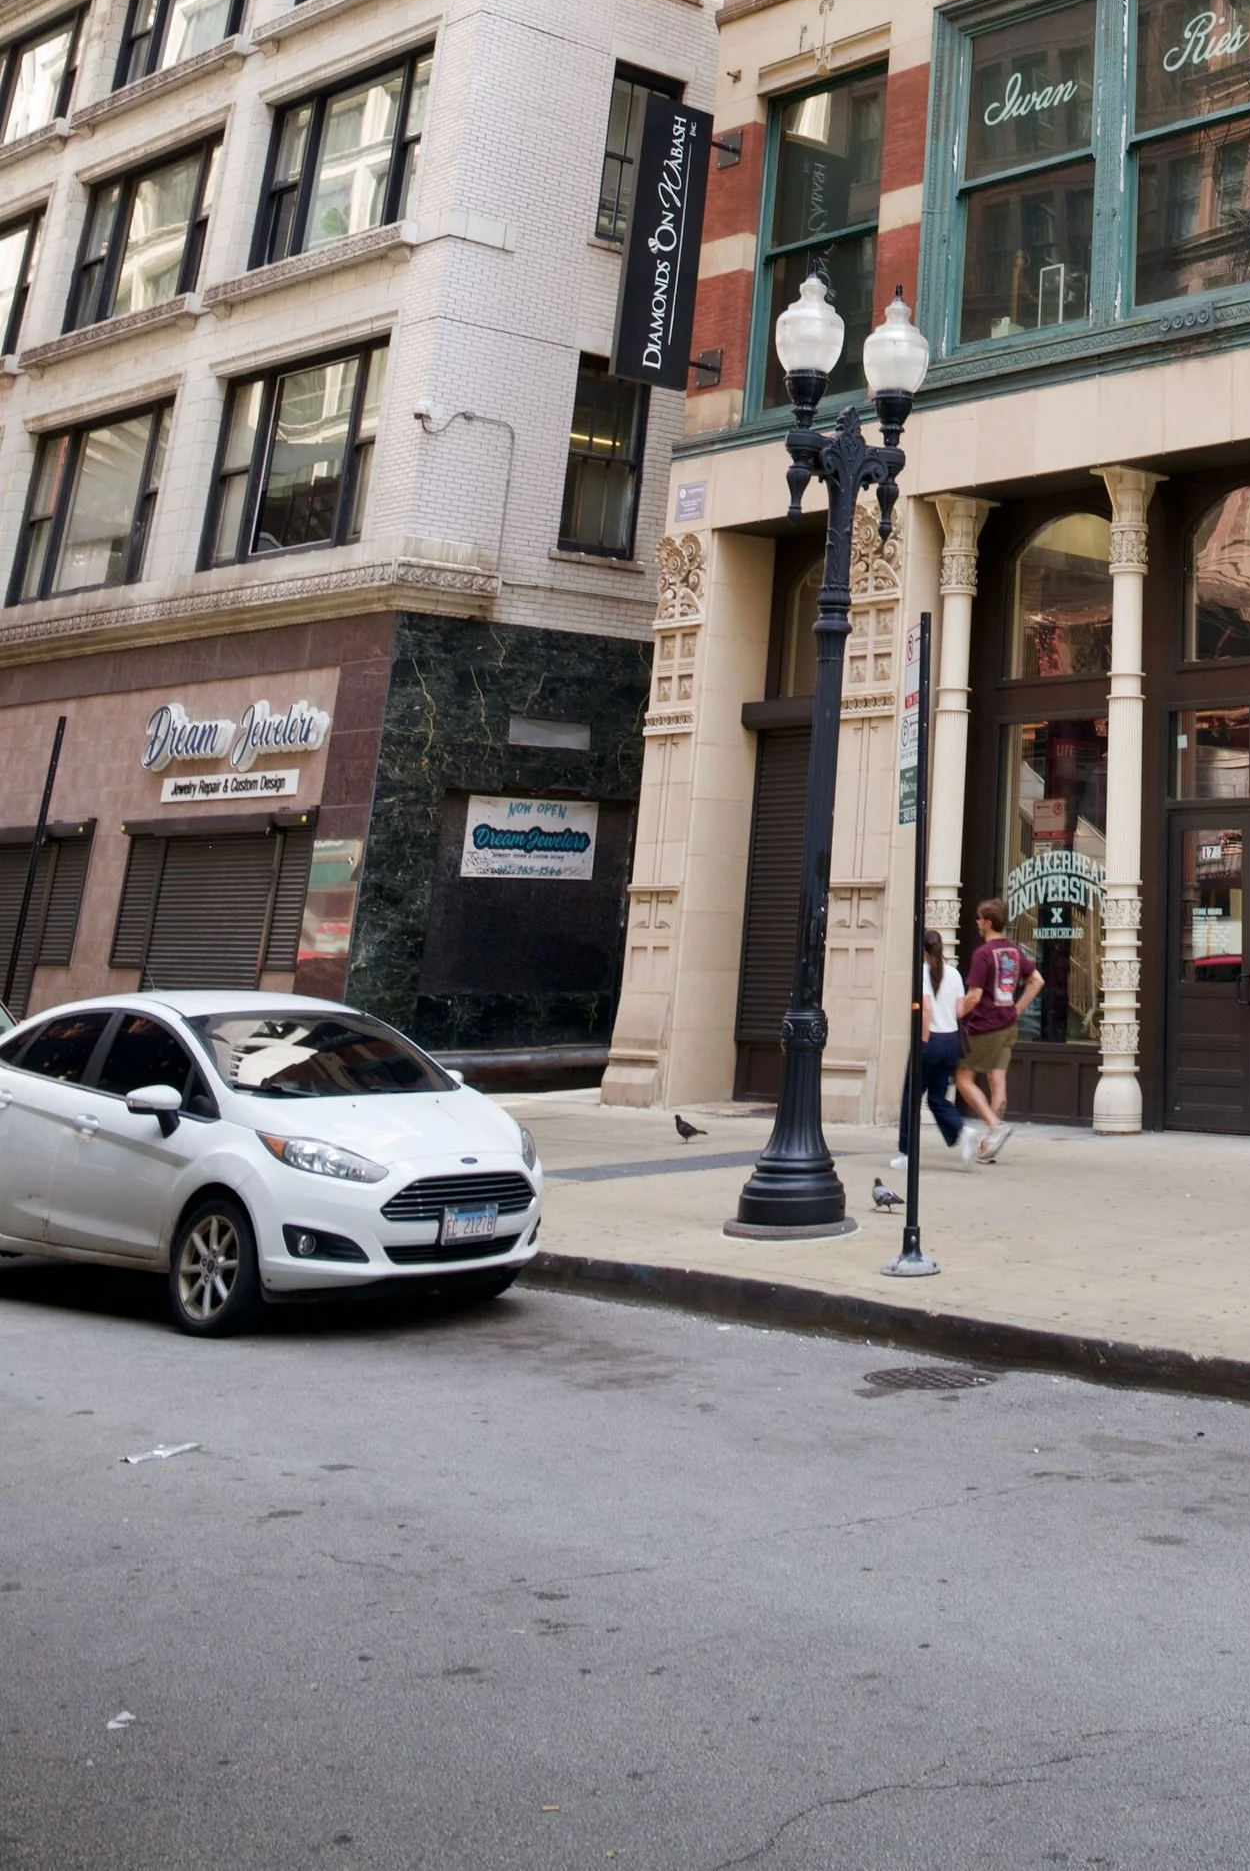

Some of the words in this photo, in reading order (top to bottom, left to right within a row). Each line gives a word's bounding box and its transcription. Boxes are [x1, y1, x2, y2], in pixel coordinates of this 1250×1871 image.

[984, 72, 1078, 126] Iwan
[657, 115, 687, 208] WABASH
[653, 210, 677, 253] ON
[643, 260, 671, 370] DIAMONDS
[142, 703, 228, 770] Dream
[231, 701, 324, 770] Jewelers
[171, 780, 197, 798] Jewelry
[198, 779, 220, 797] Repair
[222, 779, 228, 793] &
[230, 777, 258, 793] Custom
[260, 775, 286, 793] Design
[507, 801, 533, 819] NOW
[537, 803, 568, 819] OPEN
[475, 828, 526, 846] Dream
[525, 830, 589, 849] Jewelers
[1007, 850, 1107, 894] SNEAKERHEAD
[1008, 874, 1107, 922] UNIVERSITY
[1051, 907, 1063, 924] X
[1032, 927, 1050, 939] MADE
[1057, 927, 1084, 939] CHICAGO
